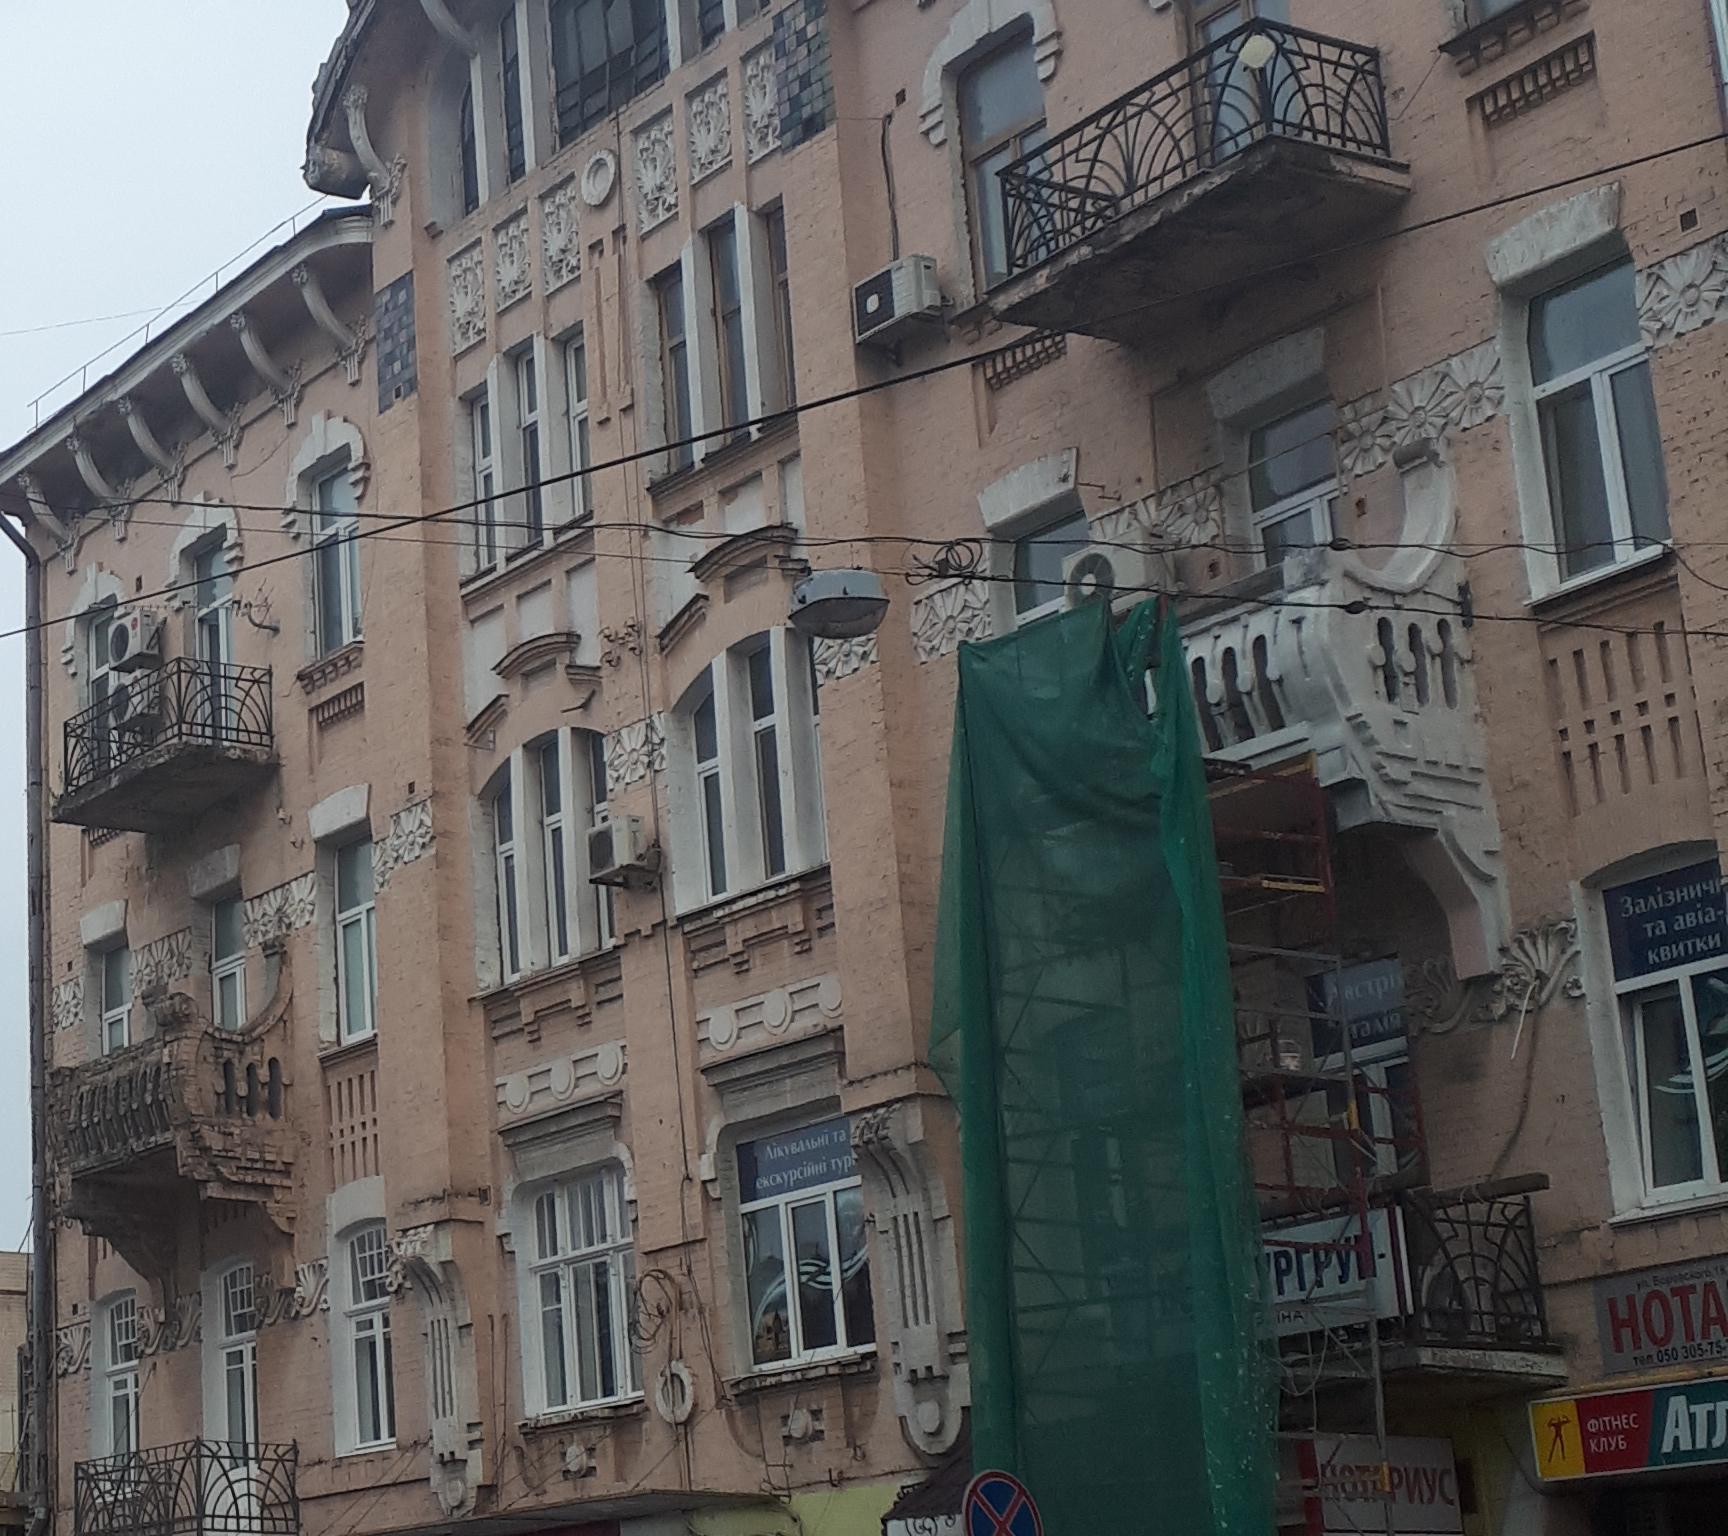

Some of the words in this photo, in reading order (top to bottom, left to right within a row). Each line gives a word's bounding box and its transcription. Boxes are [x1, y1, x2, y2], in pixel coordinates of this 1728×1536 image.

[1642, 919, 1667, 938] та
[1647, 933, 1721, 965] квитки
[1656, 1347, 1679, 1364] 050
[1587, 1413, 1640, 1434] ФІТНЕС
[1589, 1434, 1627, 1454] КЛУБ
